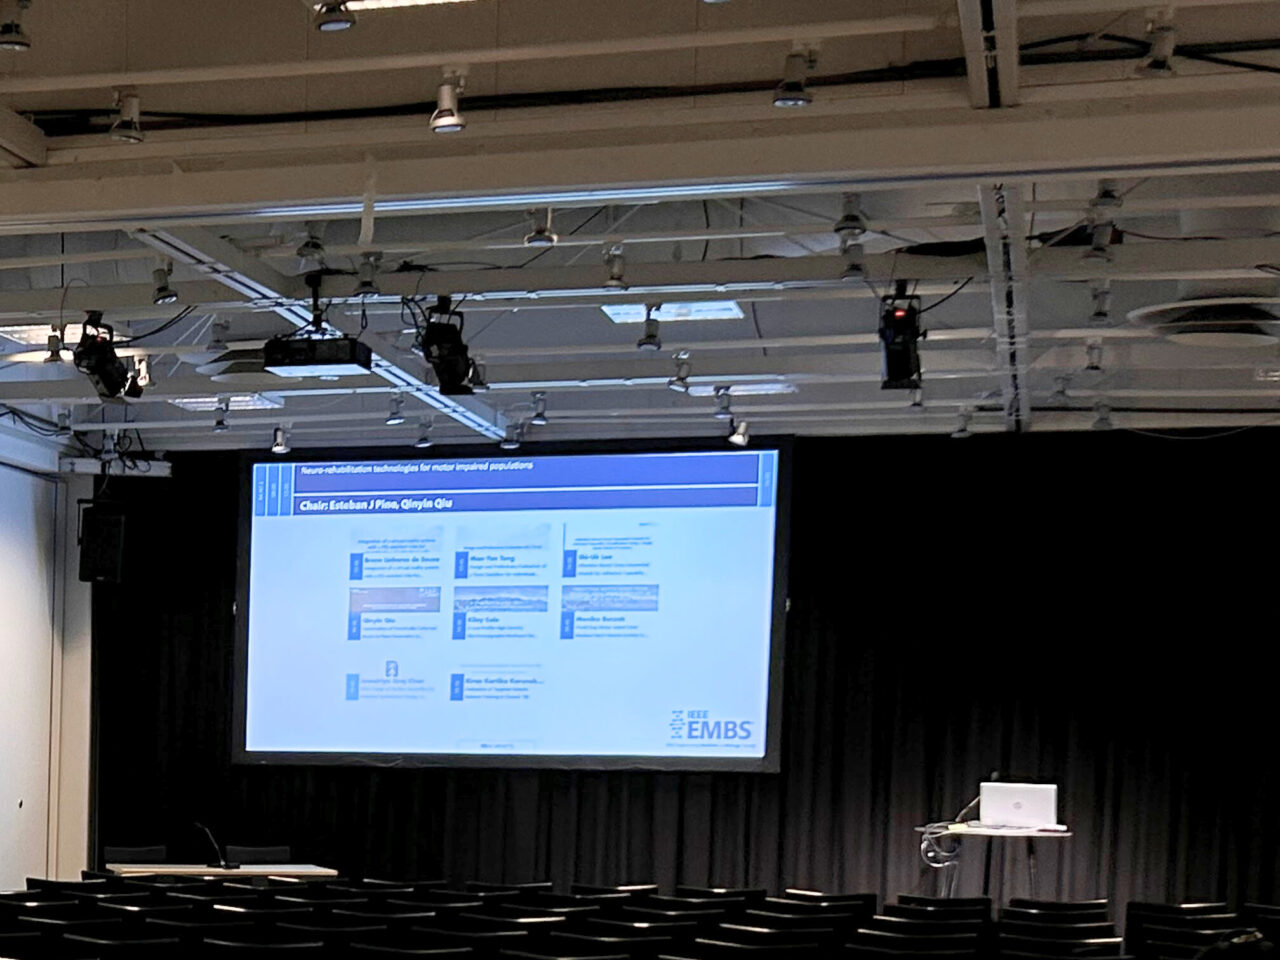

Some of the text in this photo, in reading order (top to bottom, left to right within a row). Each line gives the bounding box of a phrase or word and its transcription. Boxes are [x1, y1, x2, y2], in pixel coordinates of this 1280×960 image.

[373, 463, 419, 474] technologies
[420, 463, 431, 472] for
[432, 463, 455, 472] motor
[456, 461, 489, 472] impaired
[489, 461, 534, 472] populations
[329, 499, 368, 511] Esteban
[368, 499, 376, 510] J
[375, 499, 400, 511] Pino,
[401, 498, 433, 511] Qinyin
[434, 498, 453, 510] Qiu
[687, 710, 709, 719] IEEE
[687, 721, 752, 740] EMBS
